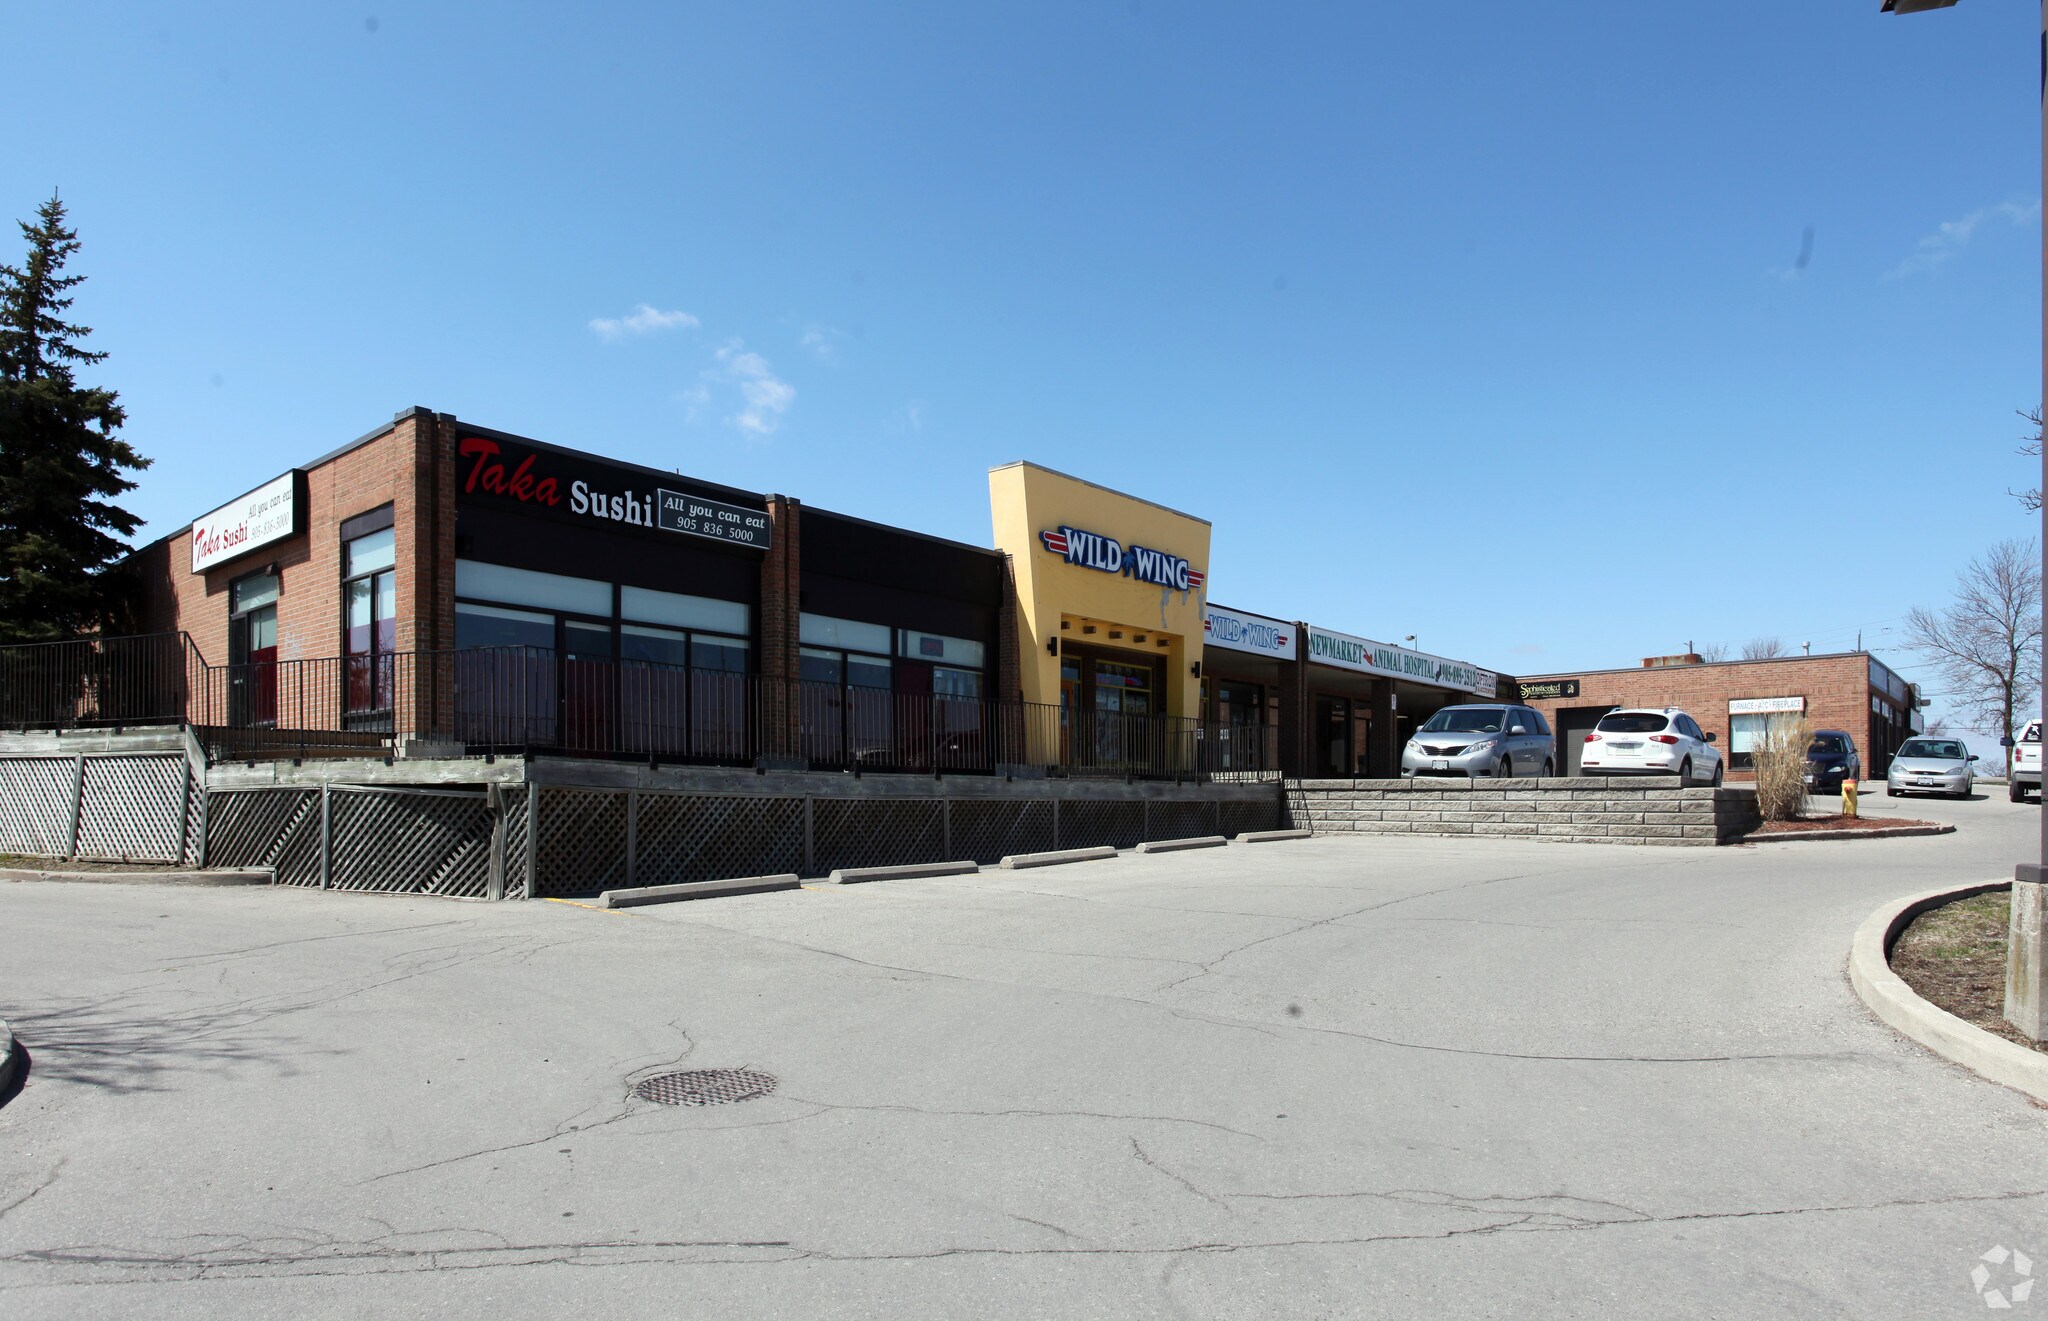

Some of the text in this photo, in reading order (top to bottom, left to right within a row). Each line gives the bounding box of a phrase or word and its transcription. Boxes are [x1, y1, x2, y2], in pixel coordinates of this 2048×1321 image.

[459, 437, 653, 527] Taka Sushi
[664, 497, 765, 529] All you can eat
[677, 516, 753, 542] 905 836 5000
[195, 520, 248, 563] Taka Sushi
[1064, 528, 1189, 590] WILD WING
[1209, 614, 1279, 650] WILD WING
[1310, 633, 1363, 664] NEWMARKET
[1373, 648, 1402, 672] ANIMAL
[1404, 654, 1435, 679] HOSPITAL
[1730, 702, 1754, 711] FURNACE
[1773, 699, 1801, 709] FIREPLACE
